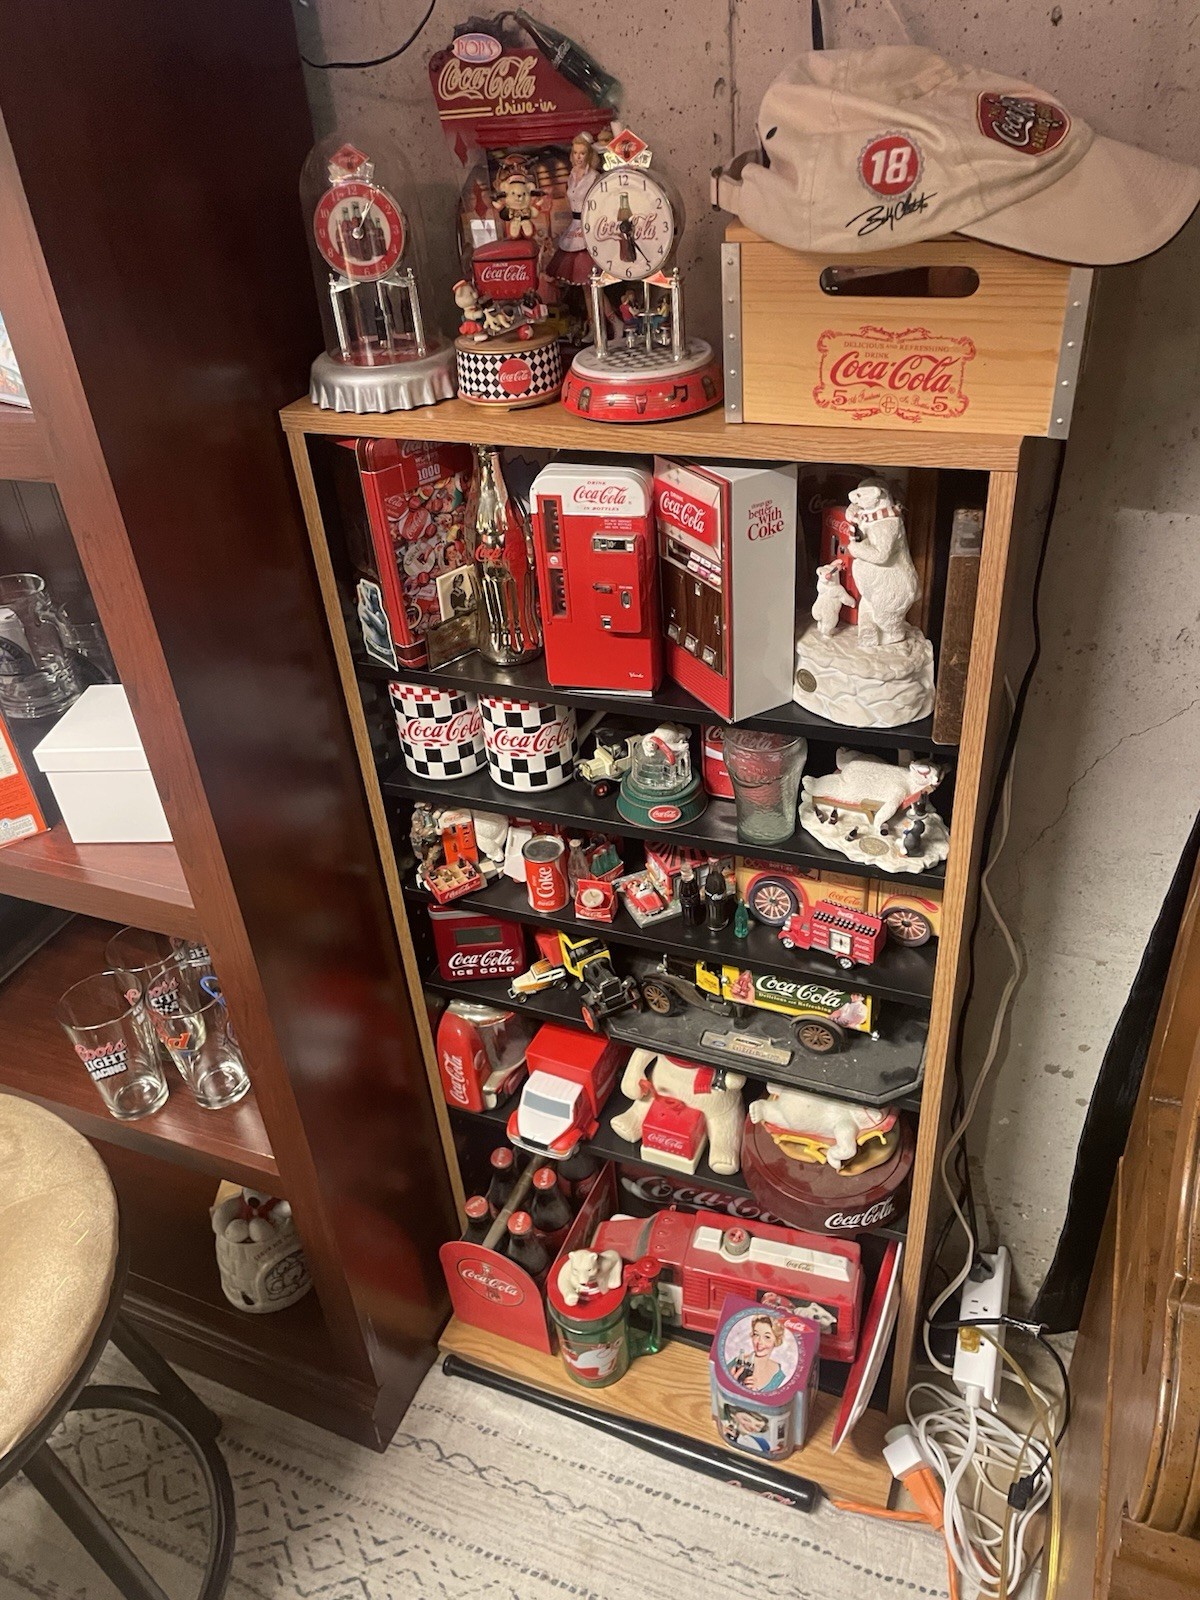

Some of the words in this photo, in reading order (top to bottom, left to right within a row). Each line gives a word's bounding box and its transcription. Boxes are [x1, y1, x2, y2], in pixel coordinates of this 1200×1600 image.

[438, 55, 539, 101] Coca-Cola
[494, 98, 557, 117] drive-in
[871, 146, 912, 186] 18
[600, 181, 609, 193] 11
[618, 174, 630, 187] 12
[642, 180, 648, 192] 1
[585, 200, 597, 212] 10
[655, 198, 663, 210] 2
[584, 222, 591, 234] 9
[662, 221, 670, 234] 3
[591, 245, 599, 257] 8
[657, 244, 665, 256] 4
[481, 264, 528, 283] Coca-Cola
[606, 260, 614, 272] 7
[625, 266, 633, 279] 6
[645, 259, 652, 272] 5
[843, 341, 886, 350] DELICIOUS
[898, 344, 951, 353] REFRESHING
[499, 369, 530, 382] Coca-Cola
[830, 351, 961, 393] Coca-Cola
[417, 463, 441, 481] 1000
[573, 485, 629, 505] Coca-Cola
[659, 490, 706, 534] Coca-Cola
[747, 504, 773, 521] better
[758, 506, 783, 525] with
[747, 519, 785, 541] Coke
[407, 705, 482, 743] Coca-Cola
[493, 716, 572, 753] Coca-Cola
[536, 866, 555, 898] Coke
[448, 948, 515, 970] Coca-Cola
[452, 969, 474, 977] ICE
[479, 965, 515, 975] COLD
[755, 974, 846, 1009] Coca-Cola
[758, 991, 788, 1004] Delicious
[797, 1001, 833, 1014] Refreshing
[75, 1038, 128, 1062] Coors
[443, 1049, 470, 1105] Coca-Cola
[647, 1133, 684, 1150] Coca-Cola
[621, 1175, 781, 1227] Coca-Co
[824, 1195, 895, 1230] Coca-Cola
[461, 1268, 518, 1296] Coca-Cola
